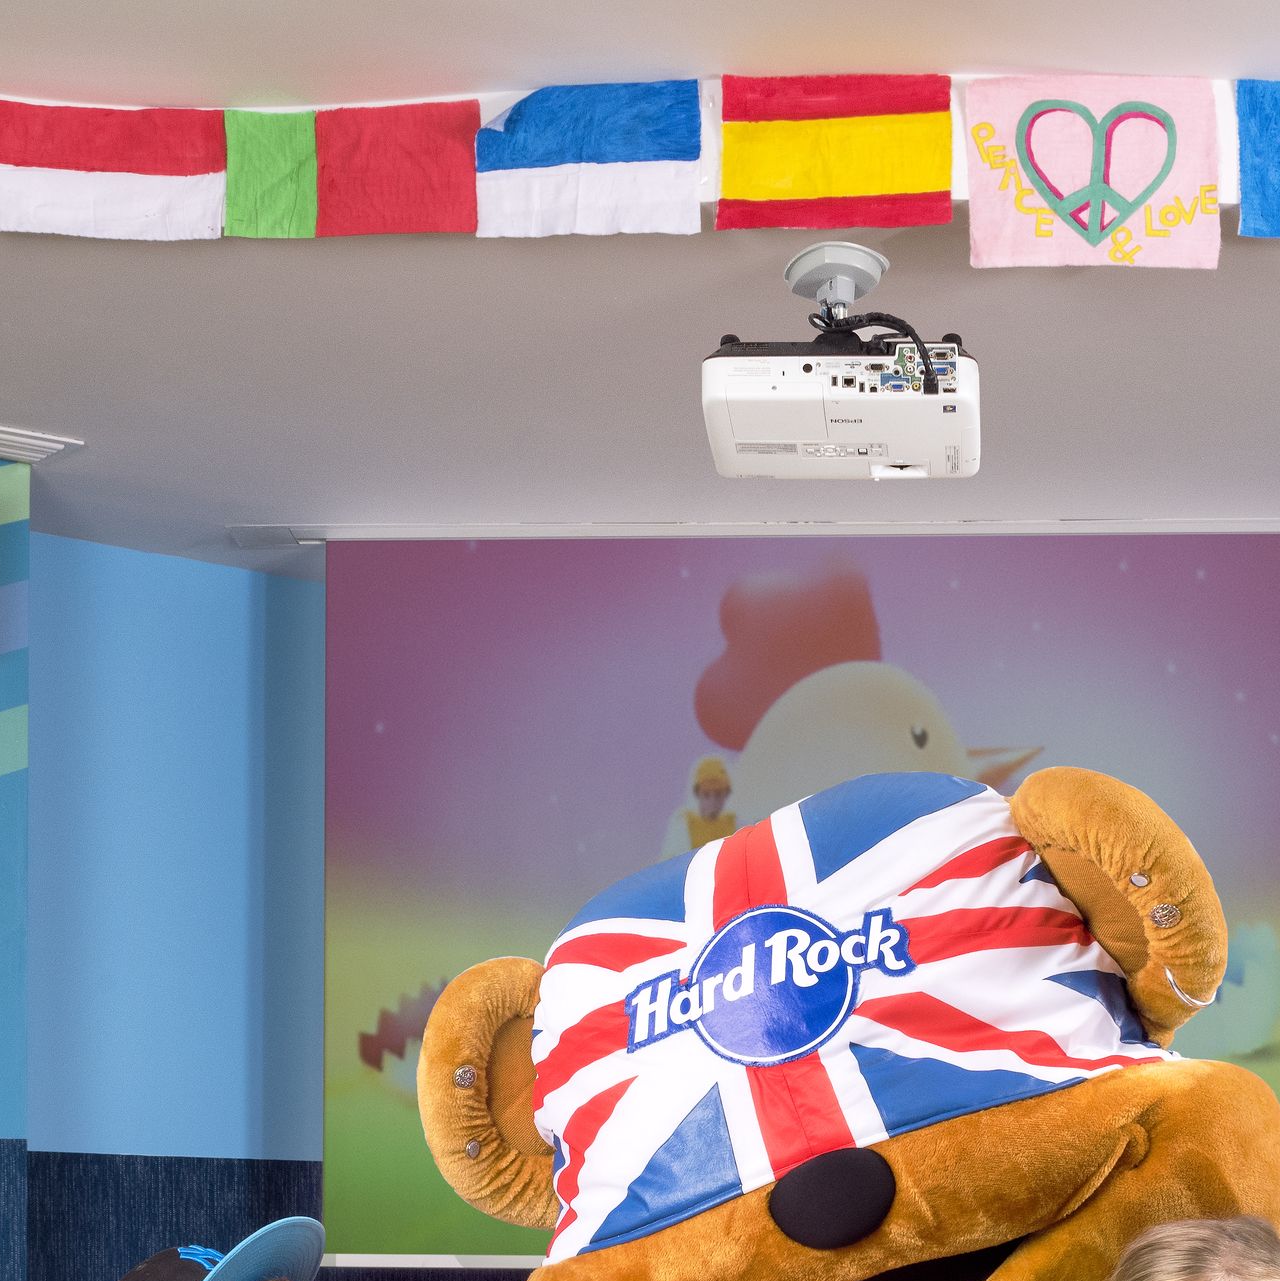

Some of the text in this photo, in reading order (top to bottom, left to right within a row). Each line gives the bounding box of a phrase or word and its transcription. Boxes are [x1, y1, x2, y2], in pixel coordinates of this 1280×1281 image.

[971, 122, 1217, 264] PEACE & LOVE
[632, 915, 907, 1044] Hard Rock
